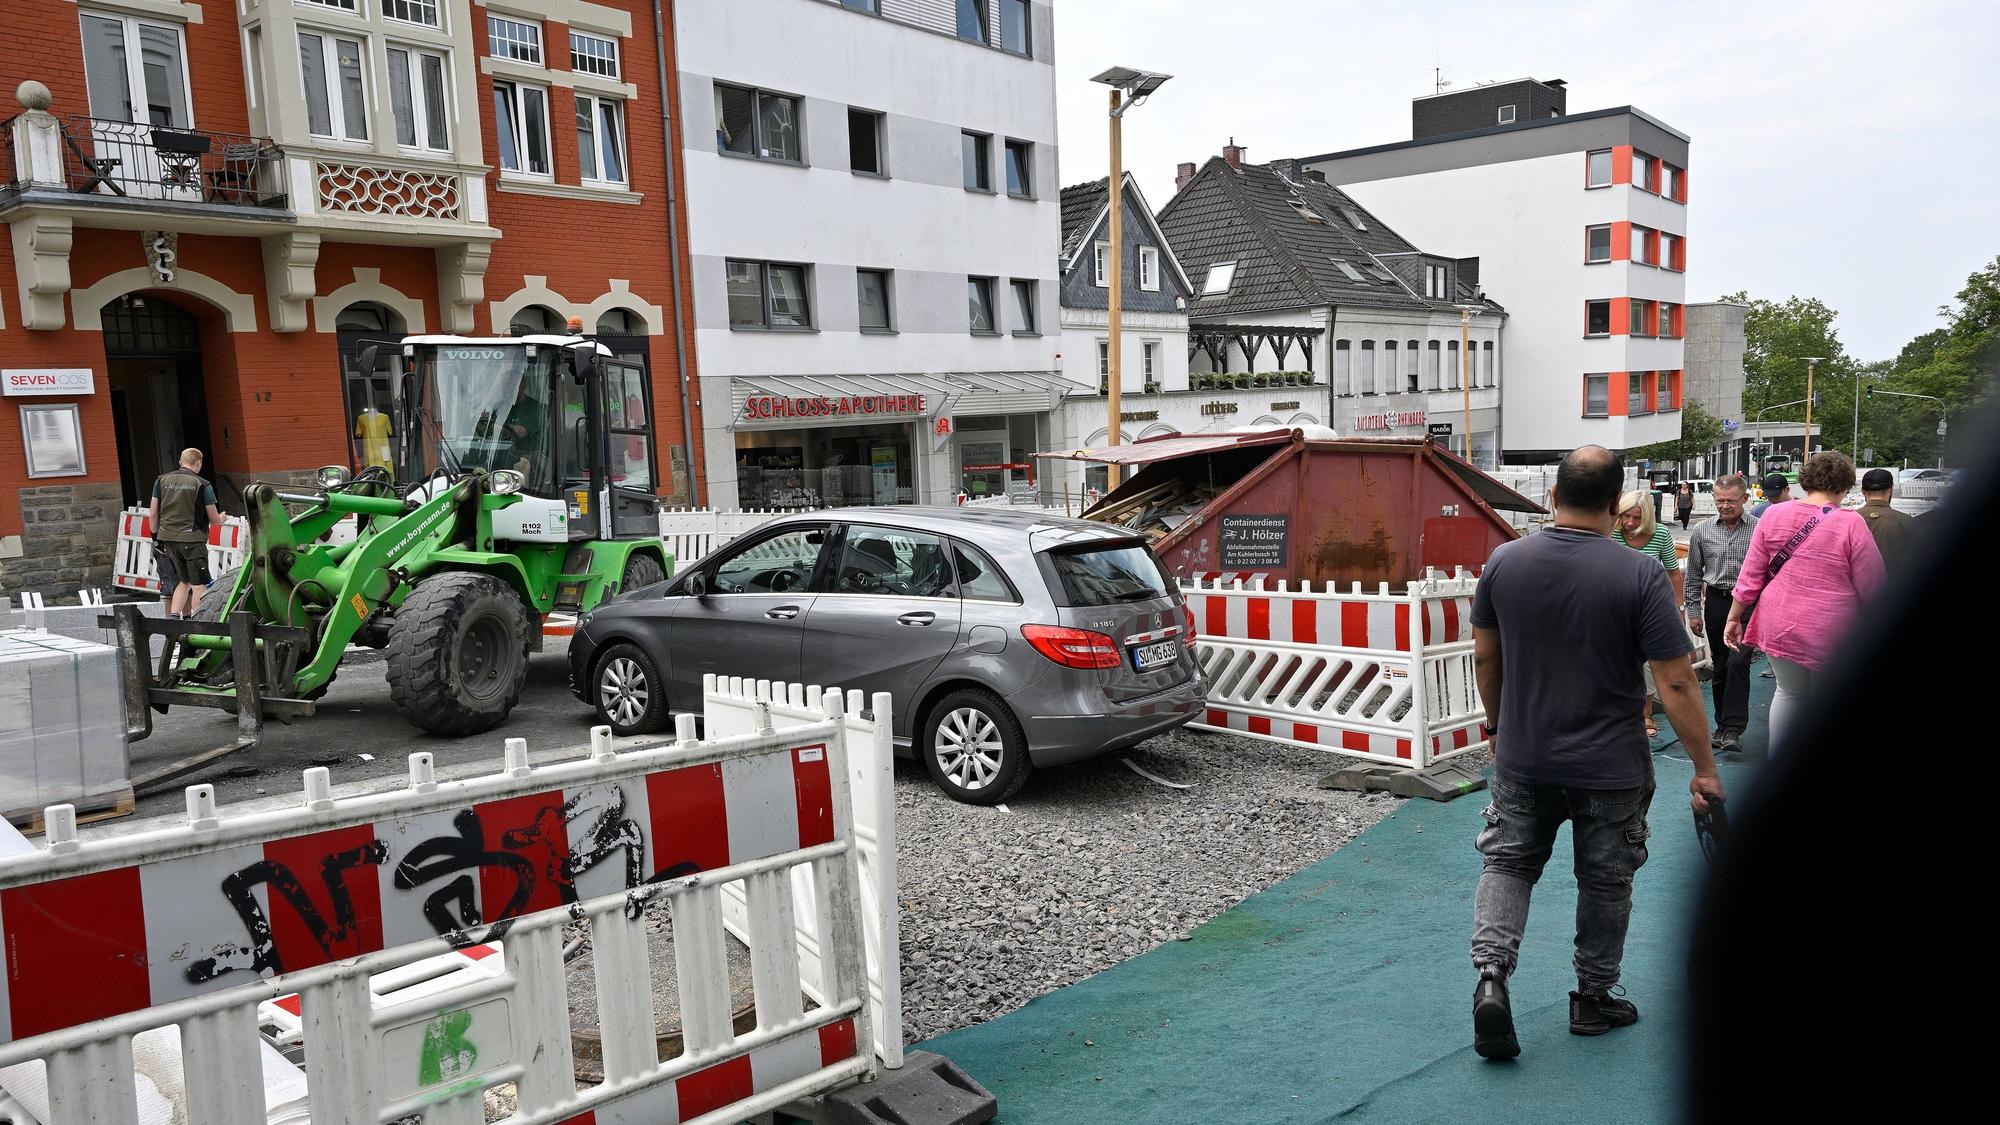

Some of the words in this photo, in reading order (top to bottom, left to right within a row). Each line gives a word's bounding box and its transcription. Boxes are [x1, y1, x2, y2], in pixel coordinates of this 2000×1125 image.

[446, 350, 505, 360] VOLVO
[11, 375, 56, 385] SEVEN
[59, 374, 87, 385] COS
[747, 394, 926, 419] SCHLOSS-APOTHEKE
[1223, 518, 1285, 527] Containerdienst
[386, 500, 451, 558] www.boymann.de
[1240, 530, 1249, 540] J.
[1252, 529, 1285, 540] Hölzer
[1139, 649, 1150, 665] SU
[1151, 645, 1163, 661] MG
[1163, 641, 1177, 659] 638
